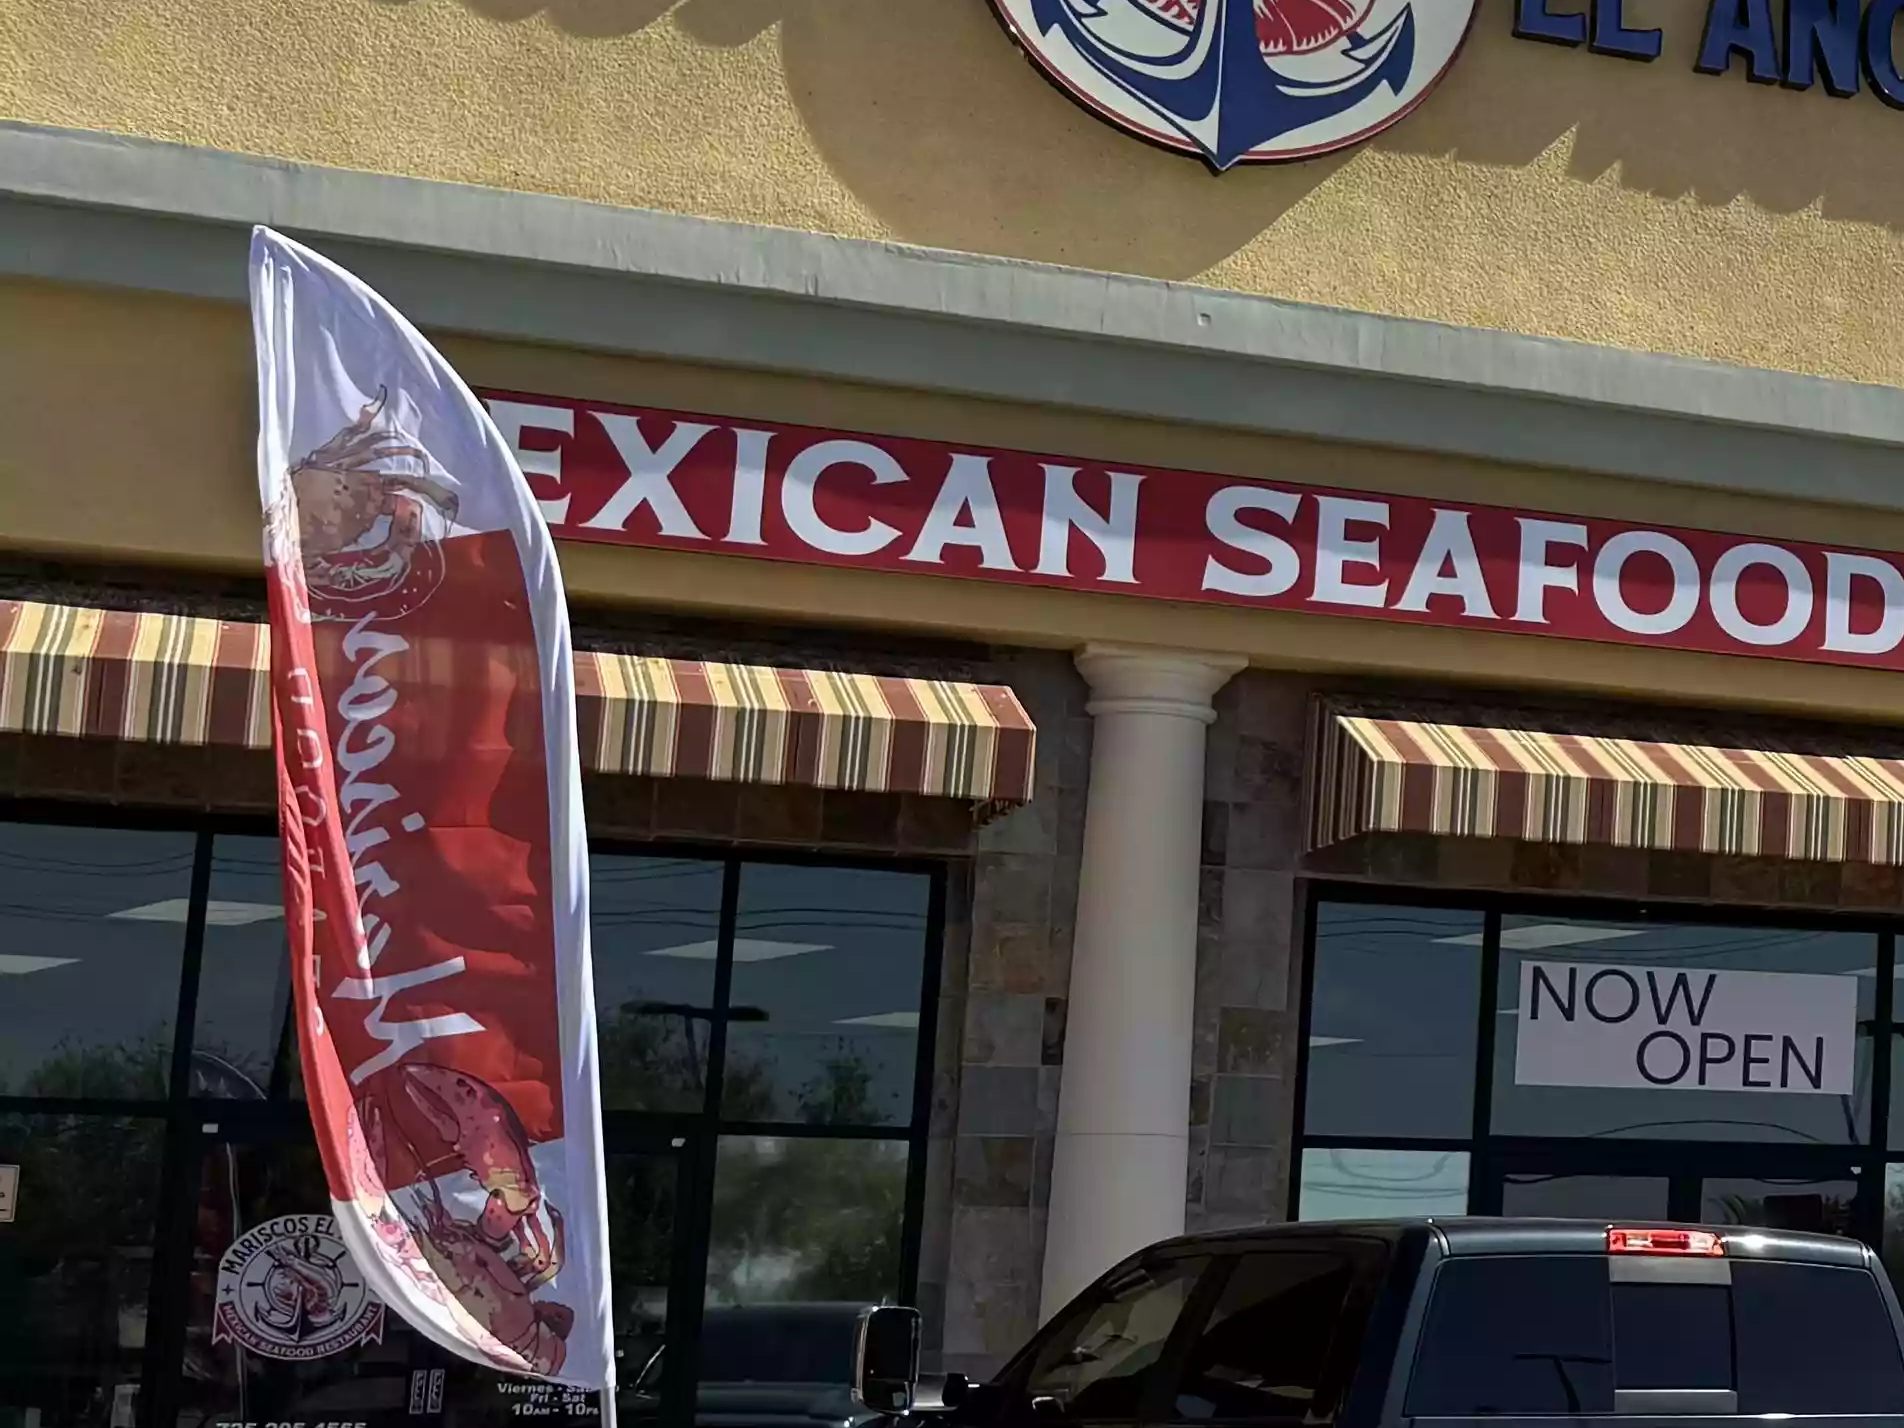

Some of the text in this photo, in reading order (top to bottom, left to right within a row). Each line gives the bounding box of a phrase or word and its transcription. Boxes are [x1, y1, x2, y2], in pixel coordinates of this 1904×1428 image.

[486, 398, 1148, 584] EXICAN
[1530, 965, 1720, 1028] NOW
[1636, 1029, 1825, 1092] OPEN
[221, 1216, 335, 1275] MARISCOS EL
